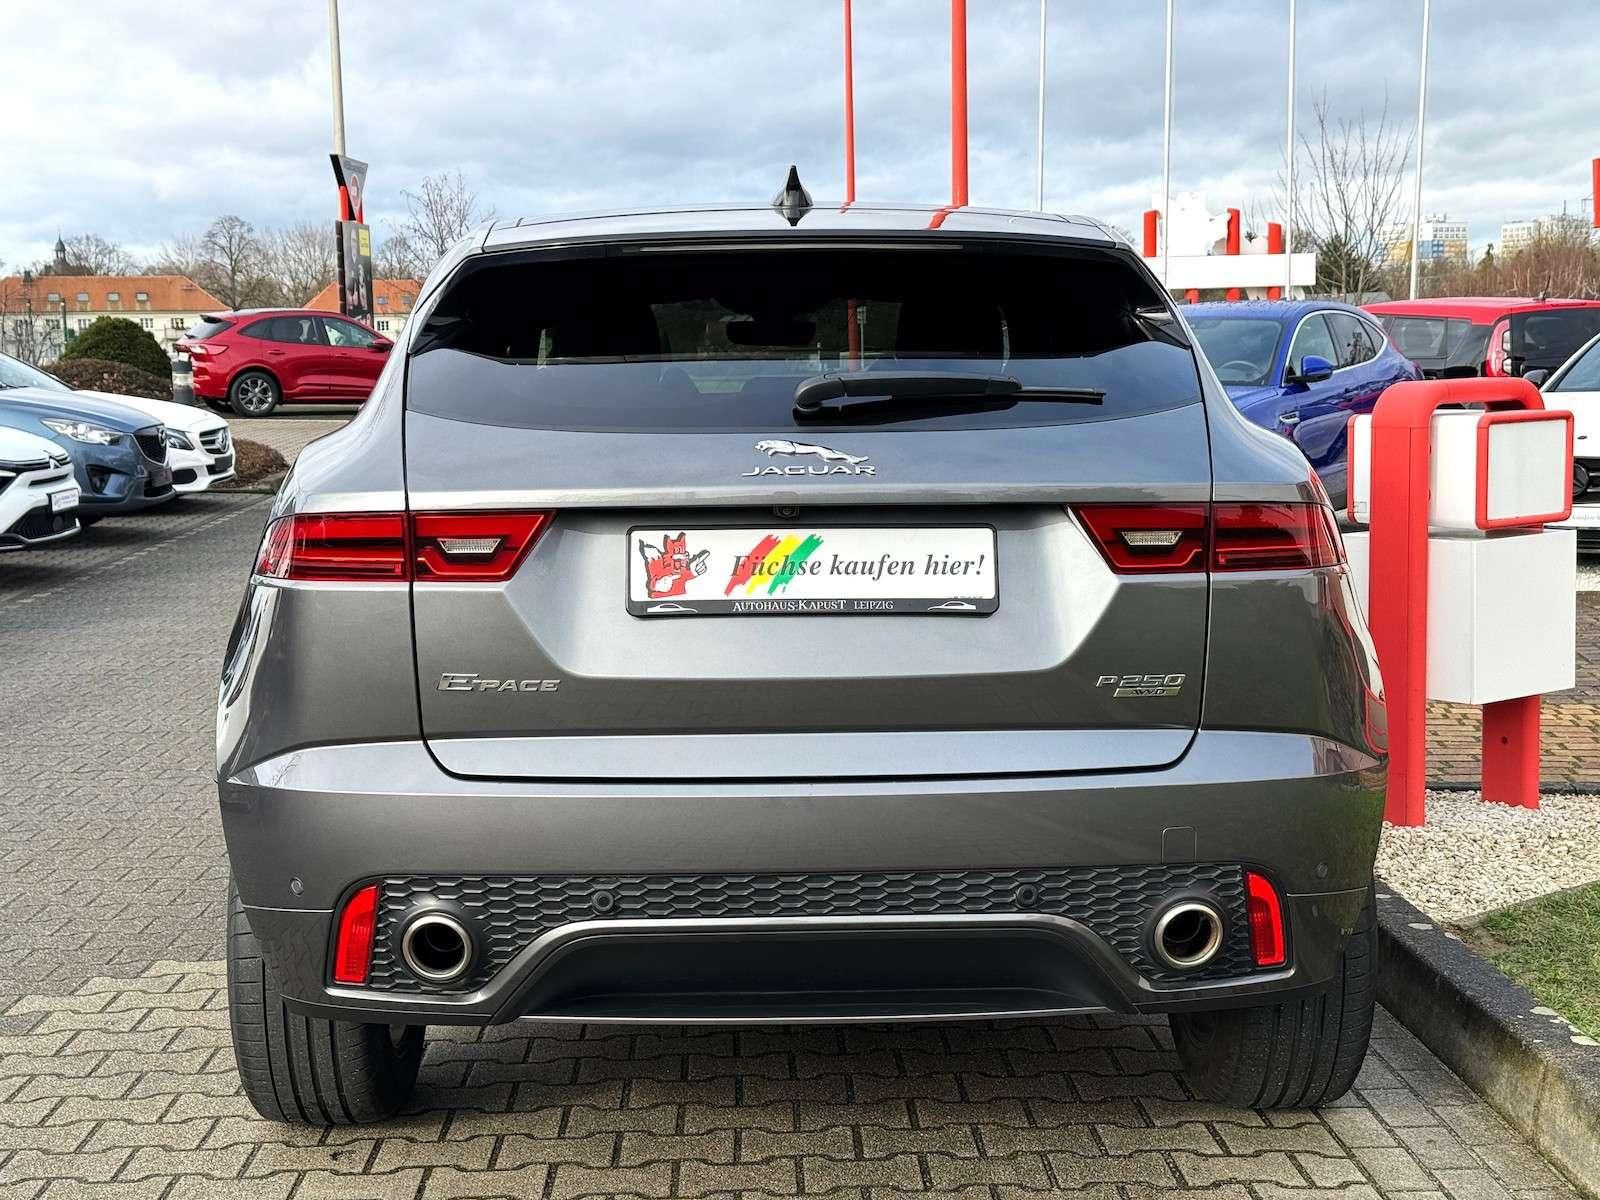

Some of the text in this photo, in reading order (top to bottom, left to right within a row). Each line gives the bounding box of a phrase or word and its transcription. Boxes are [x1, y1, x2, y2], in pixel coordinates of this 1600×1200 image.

[742, 465, 877, 477] JAGUAR
[731, 554, 985, 581] Füchse kaufen hier!
[854, 601, 894, 611] LEIPZIG
[1129, 688, 1167, 696] AWD
